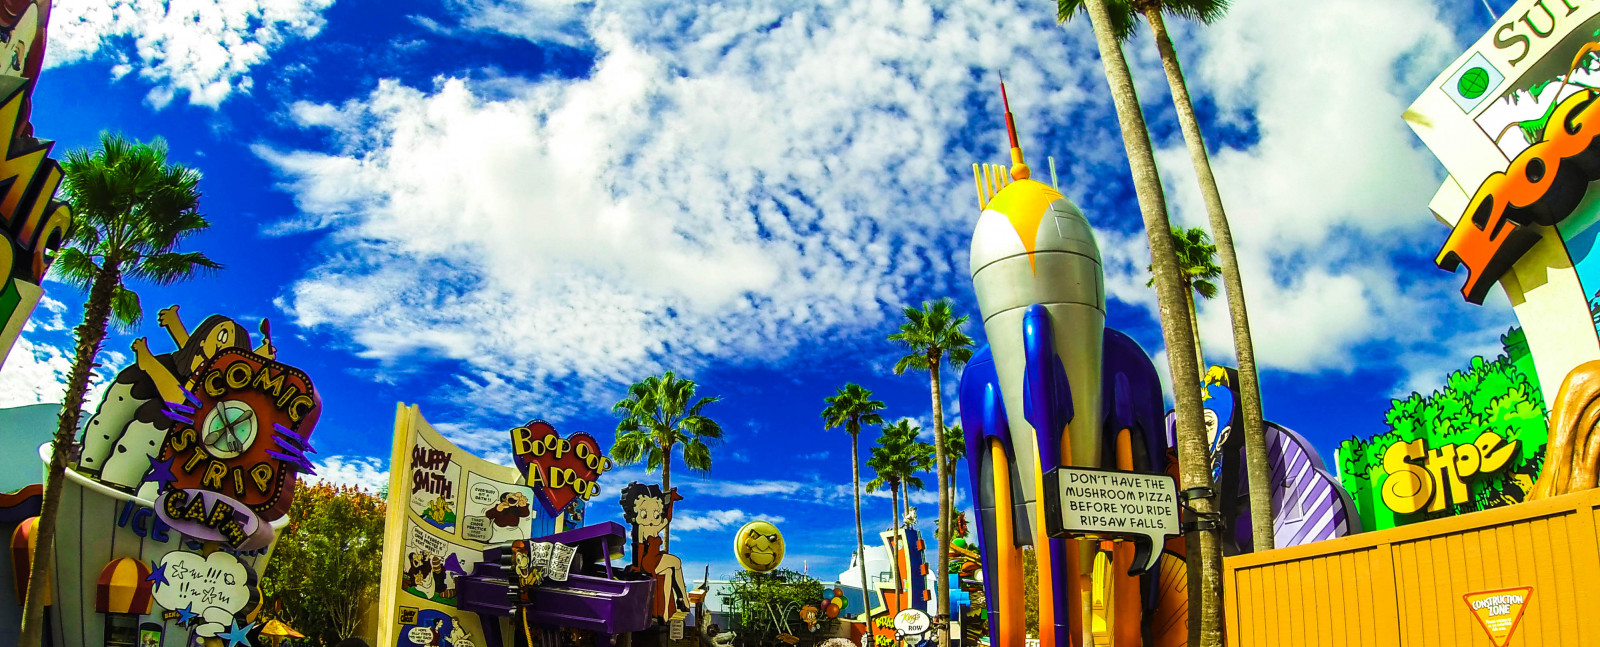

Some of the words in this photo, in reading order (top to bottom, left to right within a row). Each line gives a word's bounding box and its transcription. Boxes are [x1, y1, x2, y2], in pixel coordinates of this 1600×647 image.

[1493, 0, 1580, 67] SU
[203, 361, 314, 424] COMIC
[171, 427, 277, 499] STRIP
[512, 427, 571, 459] BOOP
[576, 443, 612, 474] OOP
[528, 463, 545, 488] A
[550, 467, 600, 500] DOOP
[1070, 472, 1108, 485] DON'T
[1111, 476, 1142, 488] HAVE
[1145, 478, 1165, 490] THE
[1065, 487, 1136, 501] MUSHROOM
[1139, 491, 1172, 503] PIZZA
[1070, 500, 1118, 513] BEFORE
[1120, 503, 1143, 515] YOU
[1146, 505, 1172, 516] RIDE
[118, 500, 170, 543] ICE
[1080, 515, 1126, 528] RIPSAW
[1130, 517, 1167, 530] FALLS.
[1472, 594, 1524, 610] CONSTRUCTION
[1489, 604, 1510, 617] ZONE
